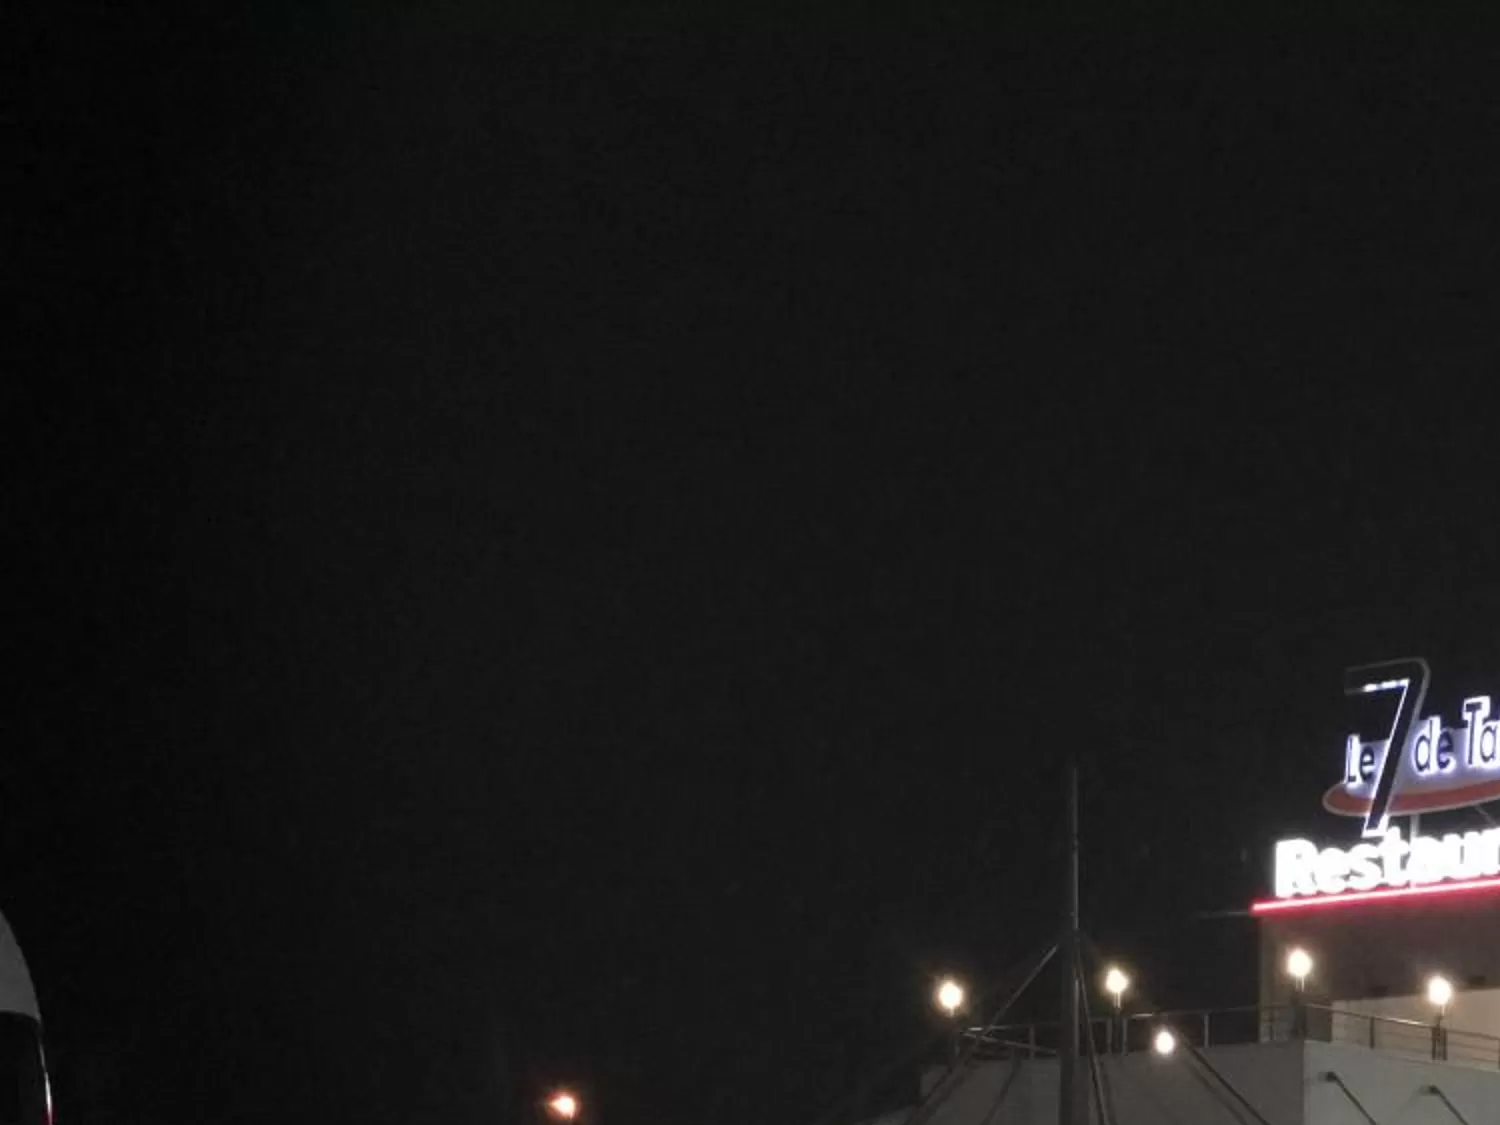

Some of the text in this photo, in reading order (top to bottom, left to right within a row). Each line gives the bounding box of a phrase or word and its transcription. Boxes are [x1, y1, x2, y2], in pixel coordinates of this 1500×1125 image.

[1344, 657, 1431, 838] 7
[1345, 734, 1376, 786] Le
[1414, 714, 1457, 775] de
